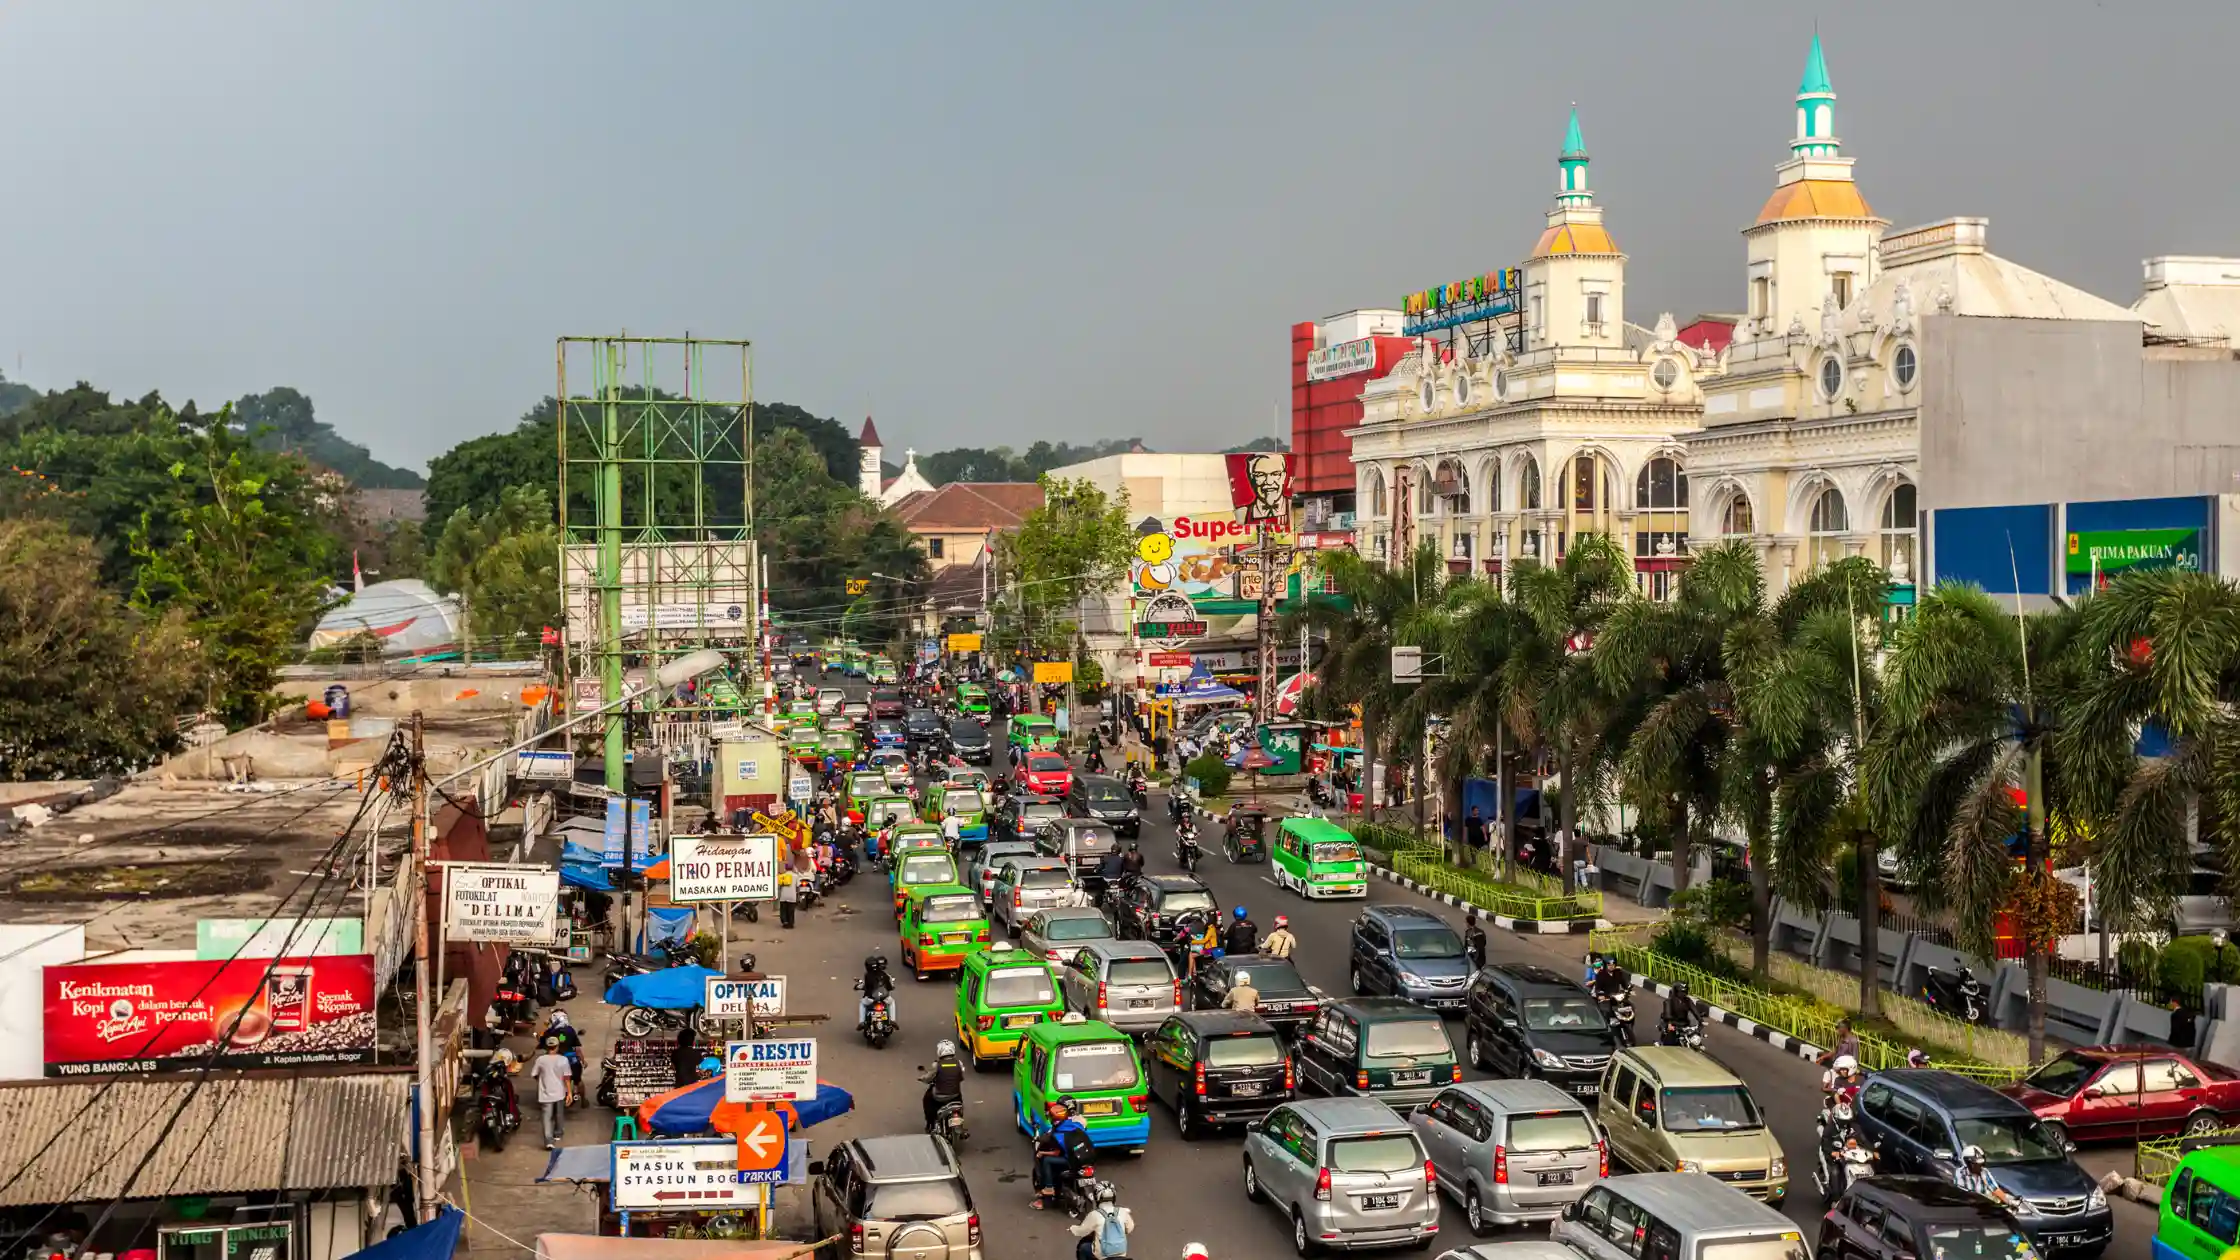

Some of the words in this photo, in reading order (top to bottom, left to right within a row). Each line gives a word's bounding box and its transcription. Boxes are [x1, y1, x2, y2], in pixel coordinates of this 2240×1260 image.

[1402, 287, 1437, 316] TAMAN
[2089, 545, 2126, 560] PRIMA
[2127, 544, 2173, 559] PAKUAN
[695, 844, 752, 859] Hidangan
[677, 862, 710, 880] TRIO
[716, 861, 771, 879] PERMAI
[481, 877, 527, 890] OPTIKAL
[680, 885, 726, 894] MASAKAN
[732, 884, 769, 893] PADANG
[59, 981, 154, 1000] Kenikmatan
[317, 990, 352, 1001] Seenak
[714, 983, 777, 999] OPTIKAL
[72, 1000, 105, 1018] Kopi
[138, 1000, 168, 1010] dalam
[323, 1001, 361, 1013] Kopinya
[721, 1001, 770, 1013] DELMA
[338, 1052, 361, 1062] Bogor
[752, 1042, 811, 1060] RESTU
[59, 1064, 90, 1075] YUNG
[142, 1061, 157, 1071] ES
[630, 1161, 684, 1171] MASUK
[694, 1159, 738, 1170] PARK
[625, 1174, 696, 1185] STASIUN
[707, 1174, 738, 1184] BOG
[743, 1170, 782, 1182] PARKIR
